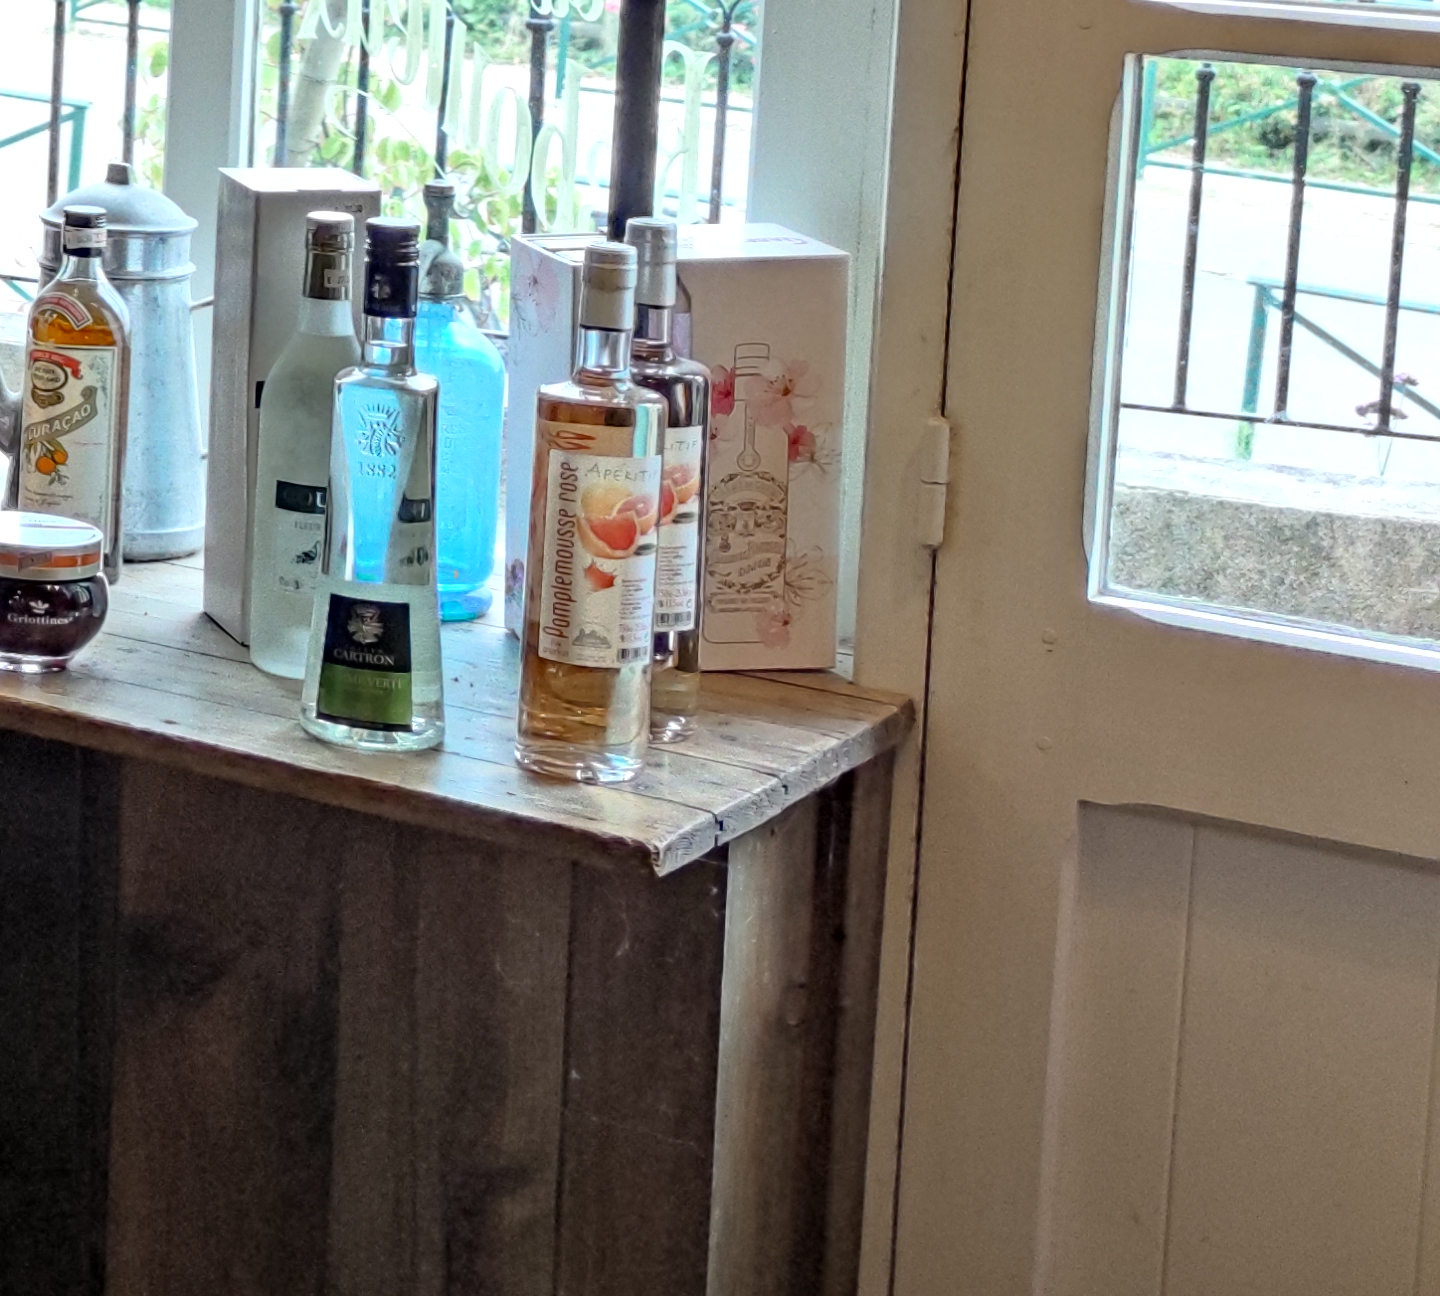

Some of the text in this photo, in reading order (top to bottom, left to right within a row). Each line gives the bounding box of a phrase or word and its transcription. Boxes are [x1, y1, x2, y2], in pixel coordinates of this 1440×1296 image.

[357, 460, 398, 479] 1882
[558, 461, 579, 504] rose
[333, 647, 395, 667] CARTRON
